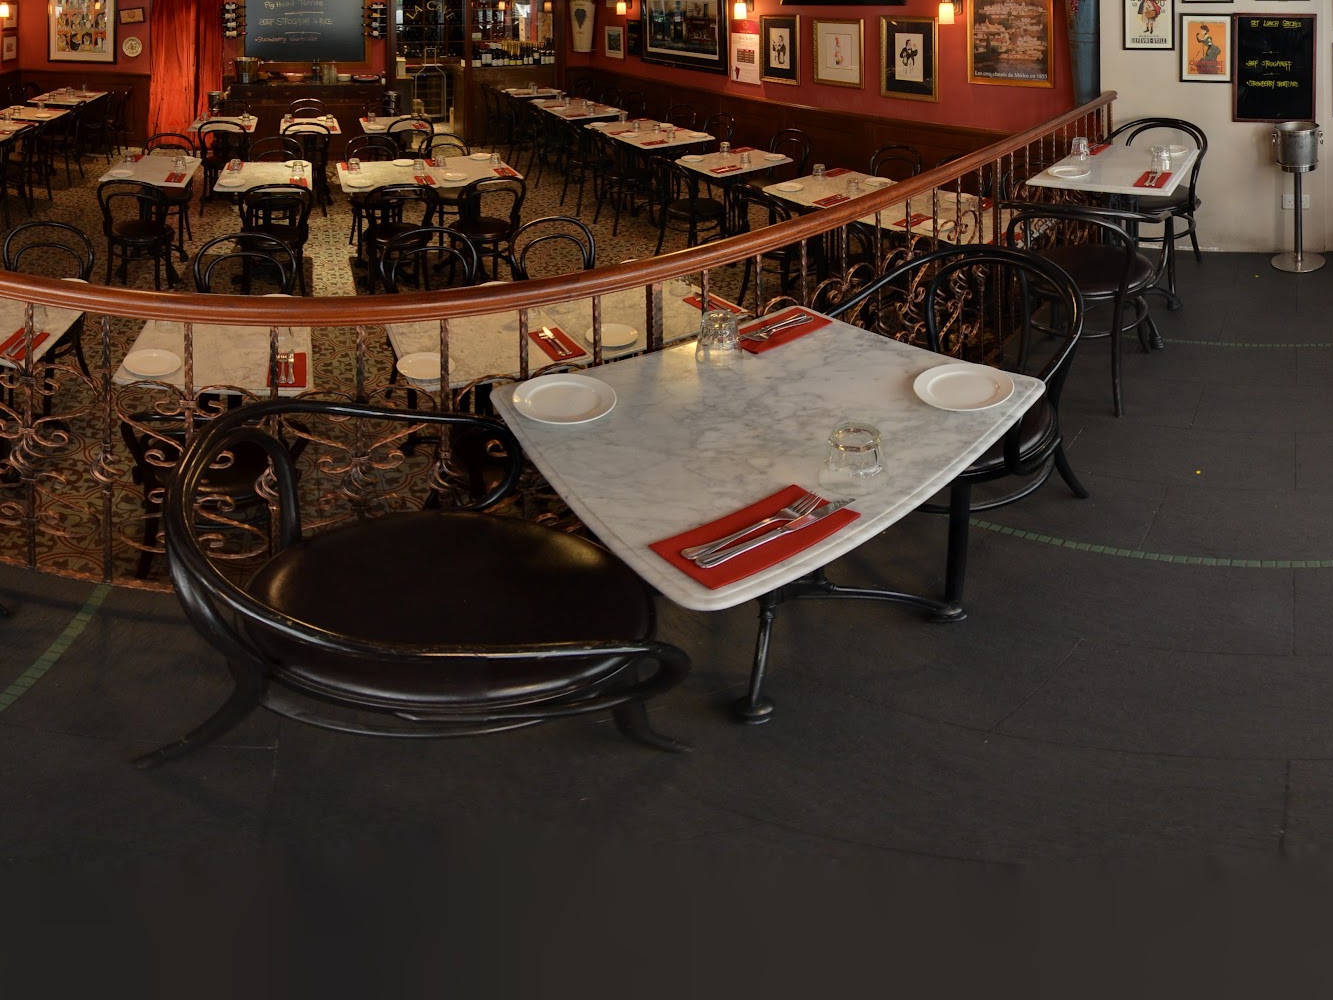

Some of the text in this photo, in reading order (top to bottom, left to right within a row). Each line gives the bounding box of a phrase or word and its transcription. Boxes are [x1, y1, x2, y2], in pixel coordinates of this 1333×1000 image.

[264, 1, 275, 10] Pig
[406, 0, 455, 20] LA CAVE
